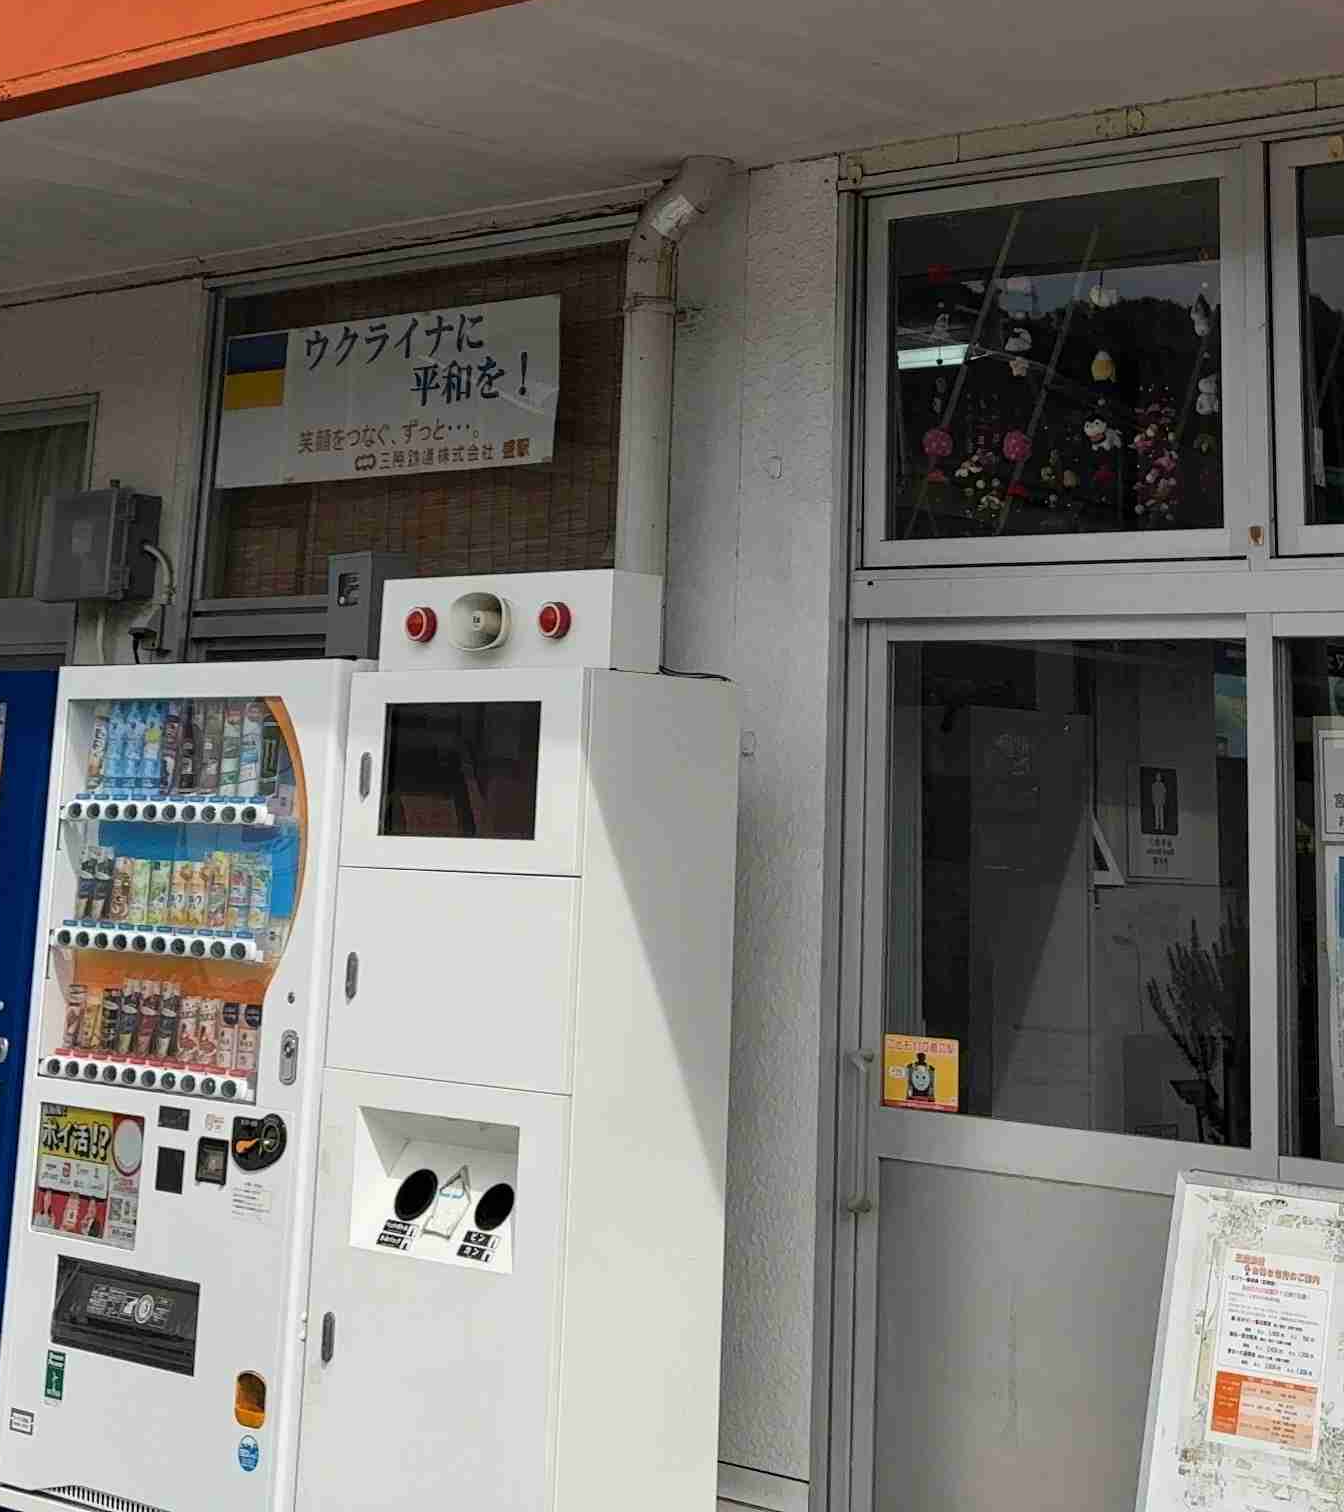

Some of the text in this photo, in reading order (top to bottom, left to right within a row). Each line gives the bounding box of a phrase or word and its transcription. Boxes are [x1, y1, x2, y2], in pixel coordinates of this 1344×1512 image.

[304, 313, 484, 371] ウクライナに
